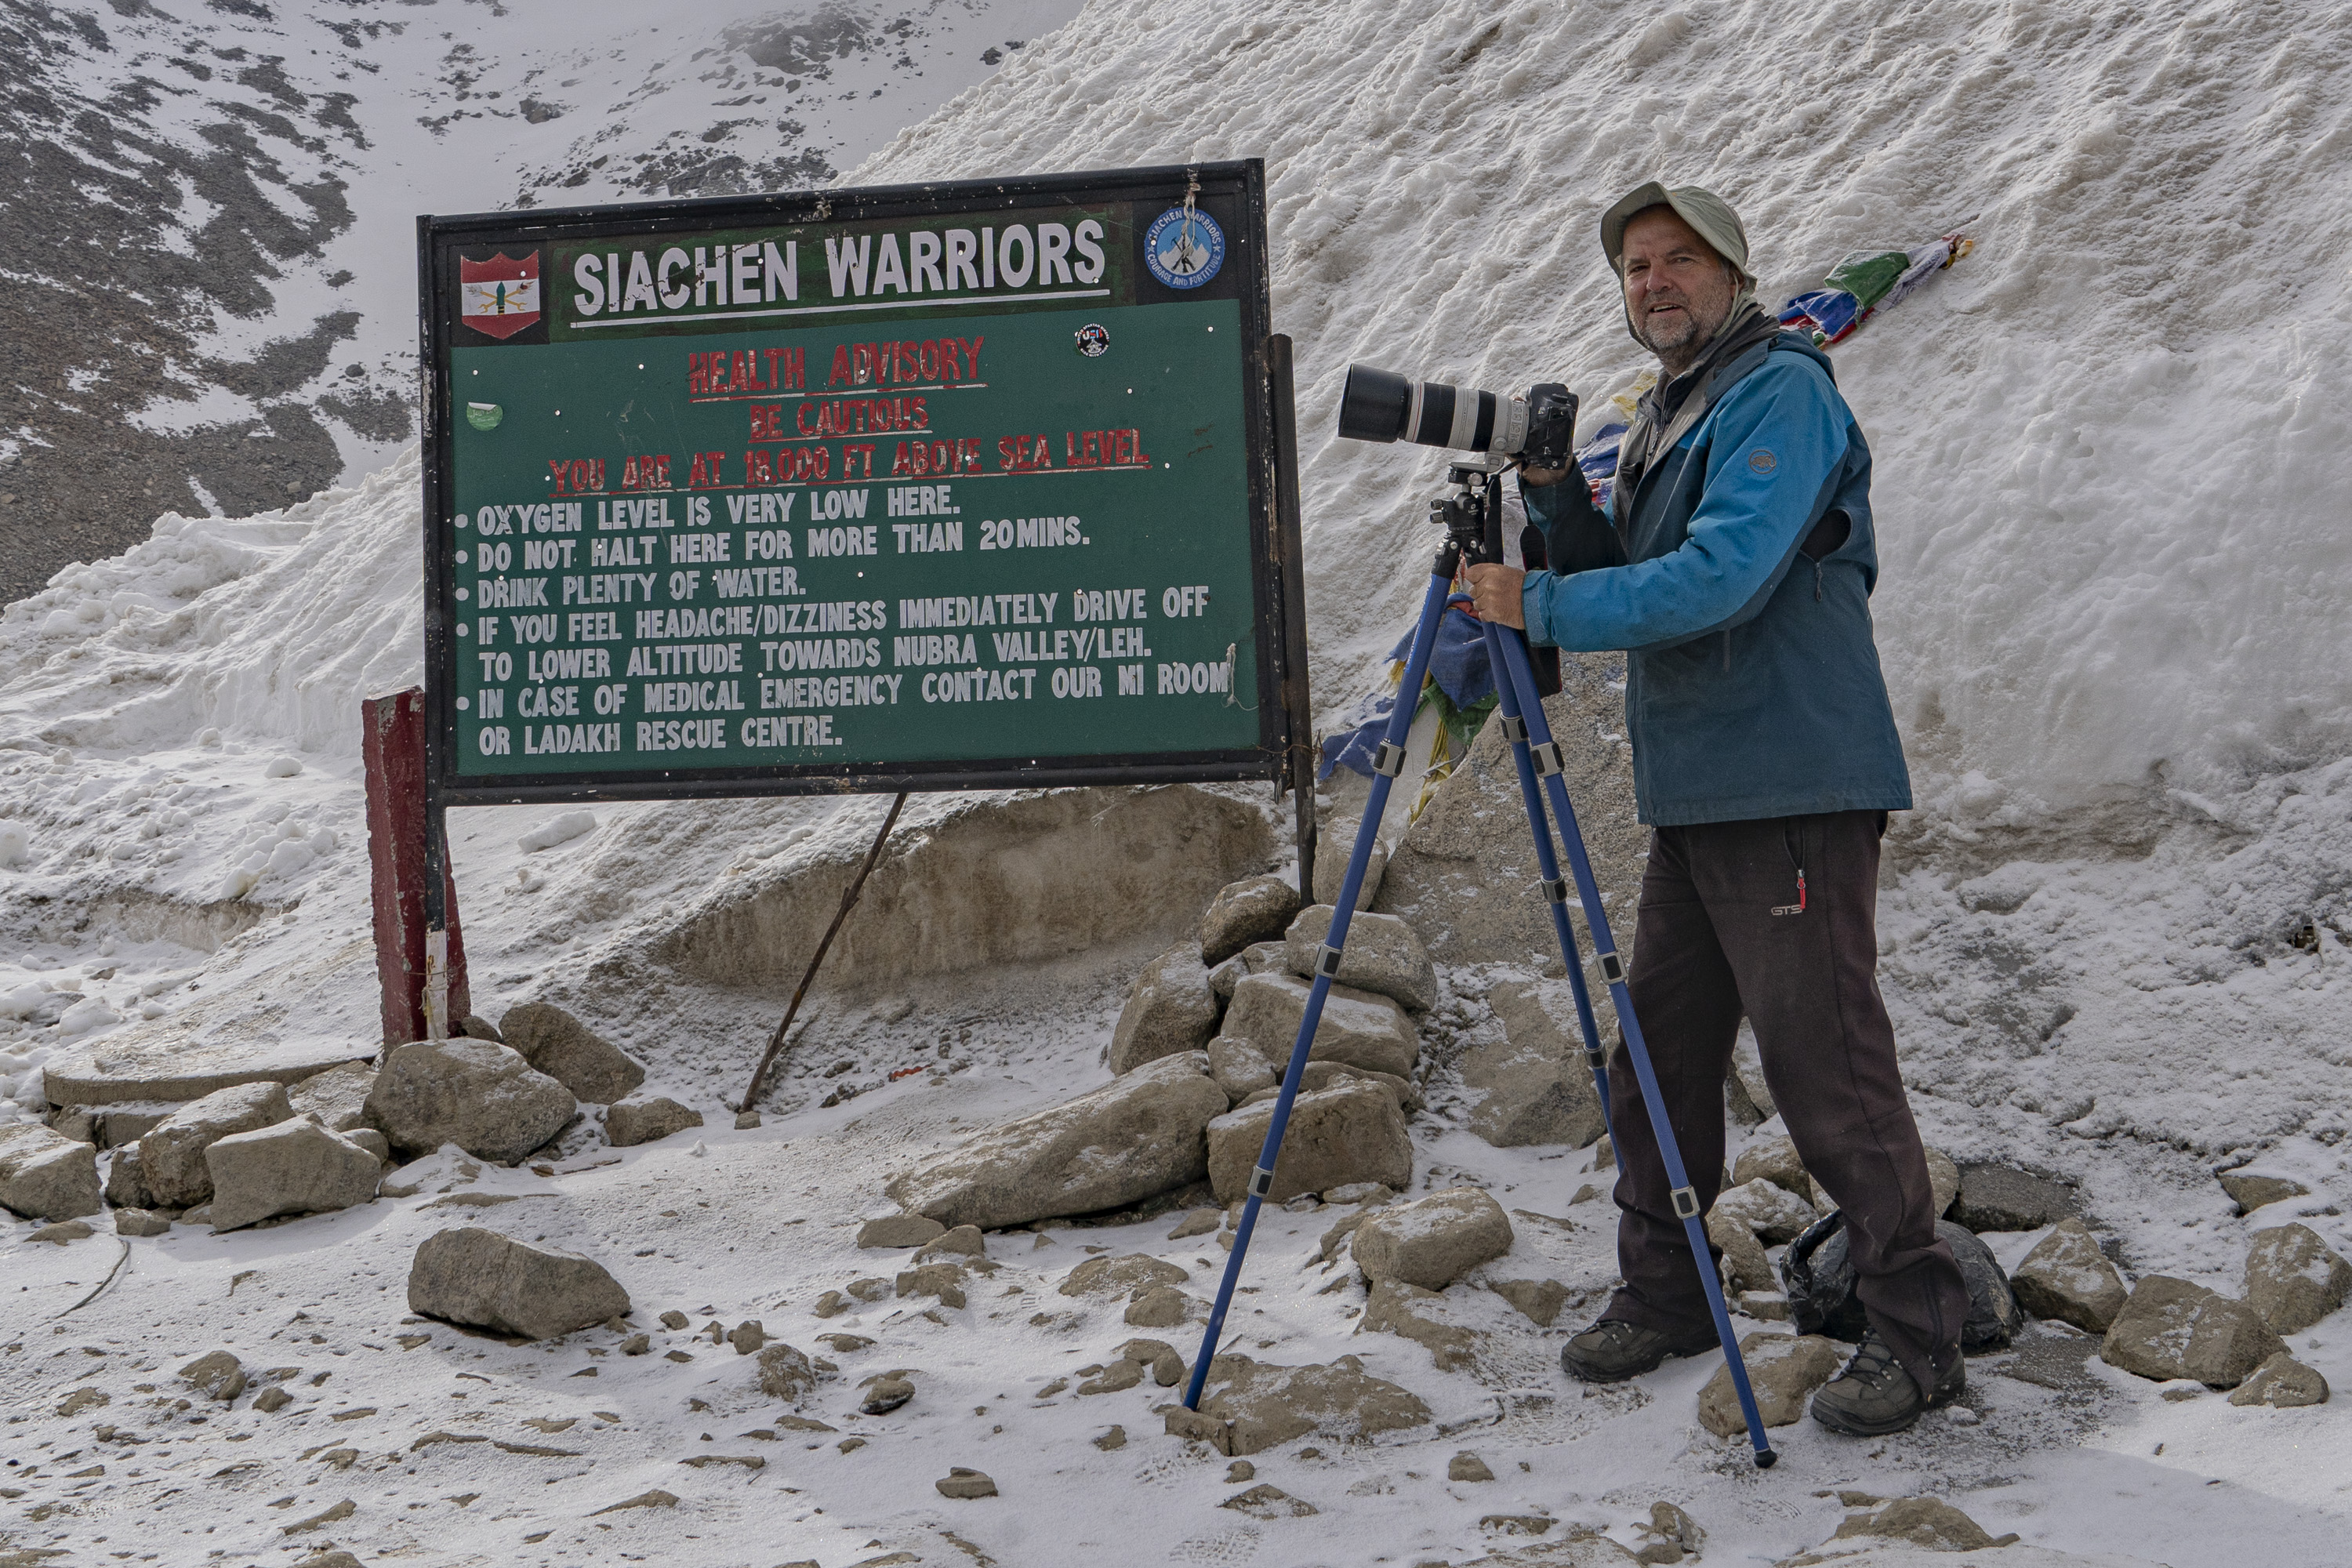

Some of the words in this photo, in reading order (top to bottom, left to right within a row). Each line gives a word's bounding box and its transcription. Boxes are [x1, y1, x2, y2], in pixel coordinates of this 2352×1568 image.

[575, 241, 798, 315] SIACHEN
[825, 220, 1105, 298] WARRIORS
[1148, 254, 1172, 282] COURAGE
[1173, 277, 1188, 286] AND
[1189, 254, 1221, 285] FORTITUDE
[1082, 329, 1103, 340] USB
[690, 347, 804, 394] HEALTH
[829, 336, 984, 385] ADVISORY
[750, 405, 782, 438] BE
[797, 397, 928, 434] CAUTIOUS
[550, 459, 604, 492] YOU
[622, 456, 671, 488] ARE
[688, 452, 725, 485] AT
[744, 446, 829, 484] 18,000
[844, 445, 875, 478] FT
[892, 438, 982, 475] ABOVE
[999, 434, 1051, 470] SEA
[1067, 429, 1149, 466] LEVEL
[477, 503, 581, 535] OXYGEN
[598, 499, 674, 530] LEVEL
[688, 496, 710, 526] IS
[726, 493, 796, 524] VERY
[811, 489, 869, 521] LOW
[888, 485, 960, 516] HERE.
[478, 543, 511, 572] DO
[525, 540, 575, 569] NOT
[592, 536, 657, 566] HALT
[671, 533, 730, 563] HERE
[746, 530, 793, 560] FOR
[808, 526, 877, 557] MORE
[892, 522, 962, 553] THAN
[478, 577, 548, 608] DRINK
[564, 573, 657, 604] PLENTY
[670, 571, 700, 600] OF
[713, 567, 805, 597] WATER.
[479, 617, 498, 644] IF
[510, 615, 557, 644] YOU
[569, 612, 622, 641] FEEL
[637, 601, 887, 637] HEADACHE/DIZZINESS
[900, 593, 1058, 628] IMMEDIATELY
[1074, 589, 1146, 621] DRIVE
[1163, 586, 1208, 617] OFF
[479, 652, 512, 681] TO
[529, 648, 610, 682] LOWER
[626, 643, 742, 676] ALTITUDE
[760, 638, 880, 670] TOWARDS
[895, 634, 977, 666] NUBRA
[993, 627, 1151, 662] VALLEY/LEH.
[479, 689, 503, 718] IN
[518, 686, 579, 717] CASE
[594, 684, 627, 714] OF
[645, 681, 744, 713] MEDICAL
[761, 674, 902, 709] EMERGENCY
[922, 667, 1036, 702] CONTACT
[1052, 667, 1102, 698] OUR
[1119, 665, 1143, 695] MI
[1158, 662, 1228, 695] ROOM
[480, 727, 510, 755] OR
[525, 723, 620, 753] LADAKH
[637, 719, 726, 750] RESCUE
[742, 716, 842, 746] CENTRE.
[1771, 904, 1802, 916] GTS
